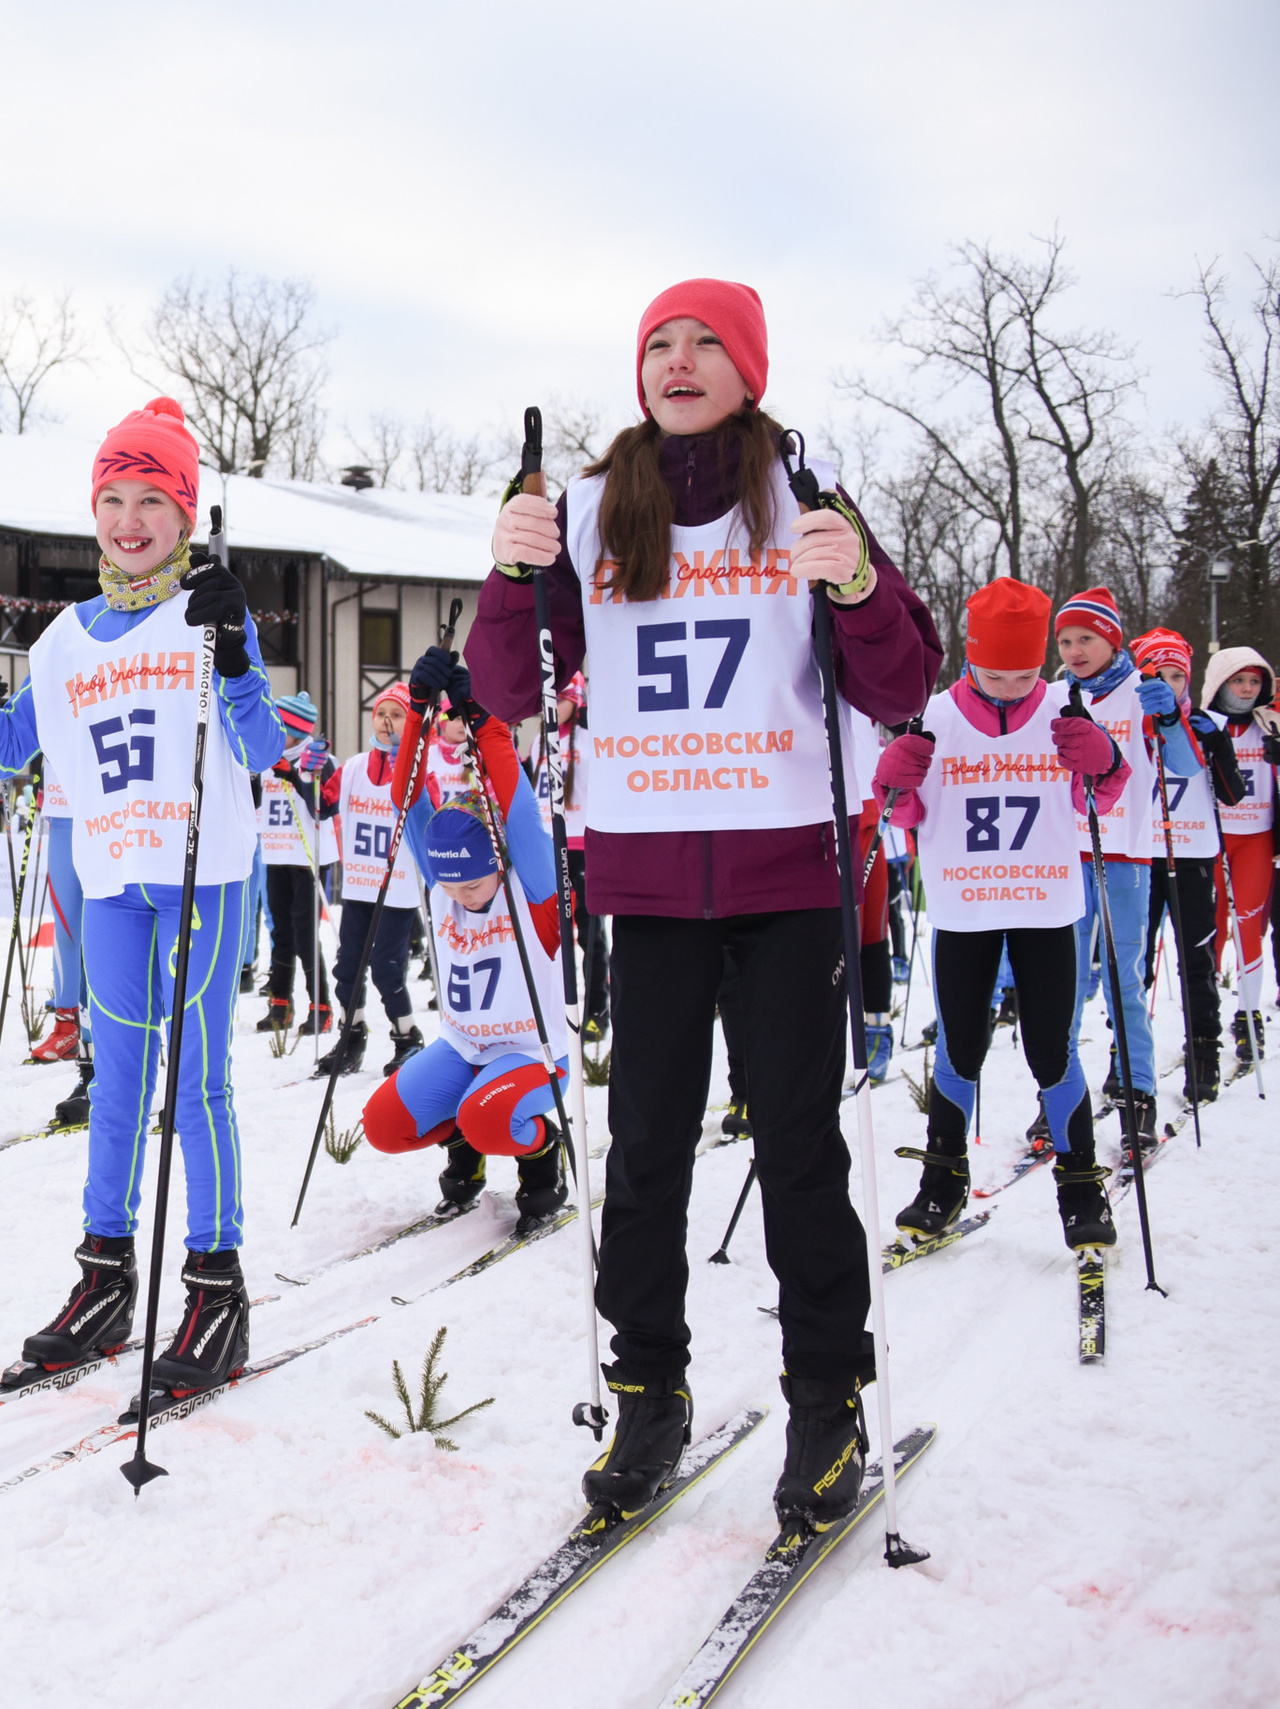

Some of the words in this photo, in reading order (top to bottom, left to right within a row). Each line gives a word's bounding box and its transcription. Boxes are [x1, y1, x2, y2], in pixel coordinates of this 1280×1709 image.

[589, 548, 799, 605] ЛЖНЯ
[637, 618, 751, 713] 57
[197, 652, 213, 714] ORDWAY
[593, 729, 794, 759] МОСКОВСКАЯ
[626, 767, 770, 793] ОБЛАСТЬ
[268, 799, 294, 827] 53
[390, 736, 426, 860] MADSHUS
[966, 796, 1041, 853] 87
[1221, 813, 1260, 821] БЛАСТЬ
[354, 821, 393, 860] 50
[427, 847, 460, 859] helvetia
[943, 864, 1069, 882] МОСКОВСКАЯ
[961, 886, 1048, 902] ОБЛАСТЬ
[447, 957, 502, 1013] 67
[479, 1082, 516, 1107] NORDSKI
[75, 1252, 122, 1267] MADSHUS
[902, 1230, 963, 1264] FISCHER
[183, 1273, 233, 1286] MADSHUS
[69, 1288, 122, 1336] MADSHUS
[607, 1381, 646, 1394] FISCHER
[813, 1437, 858, 1497] FISCHER
